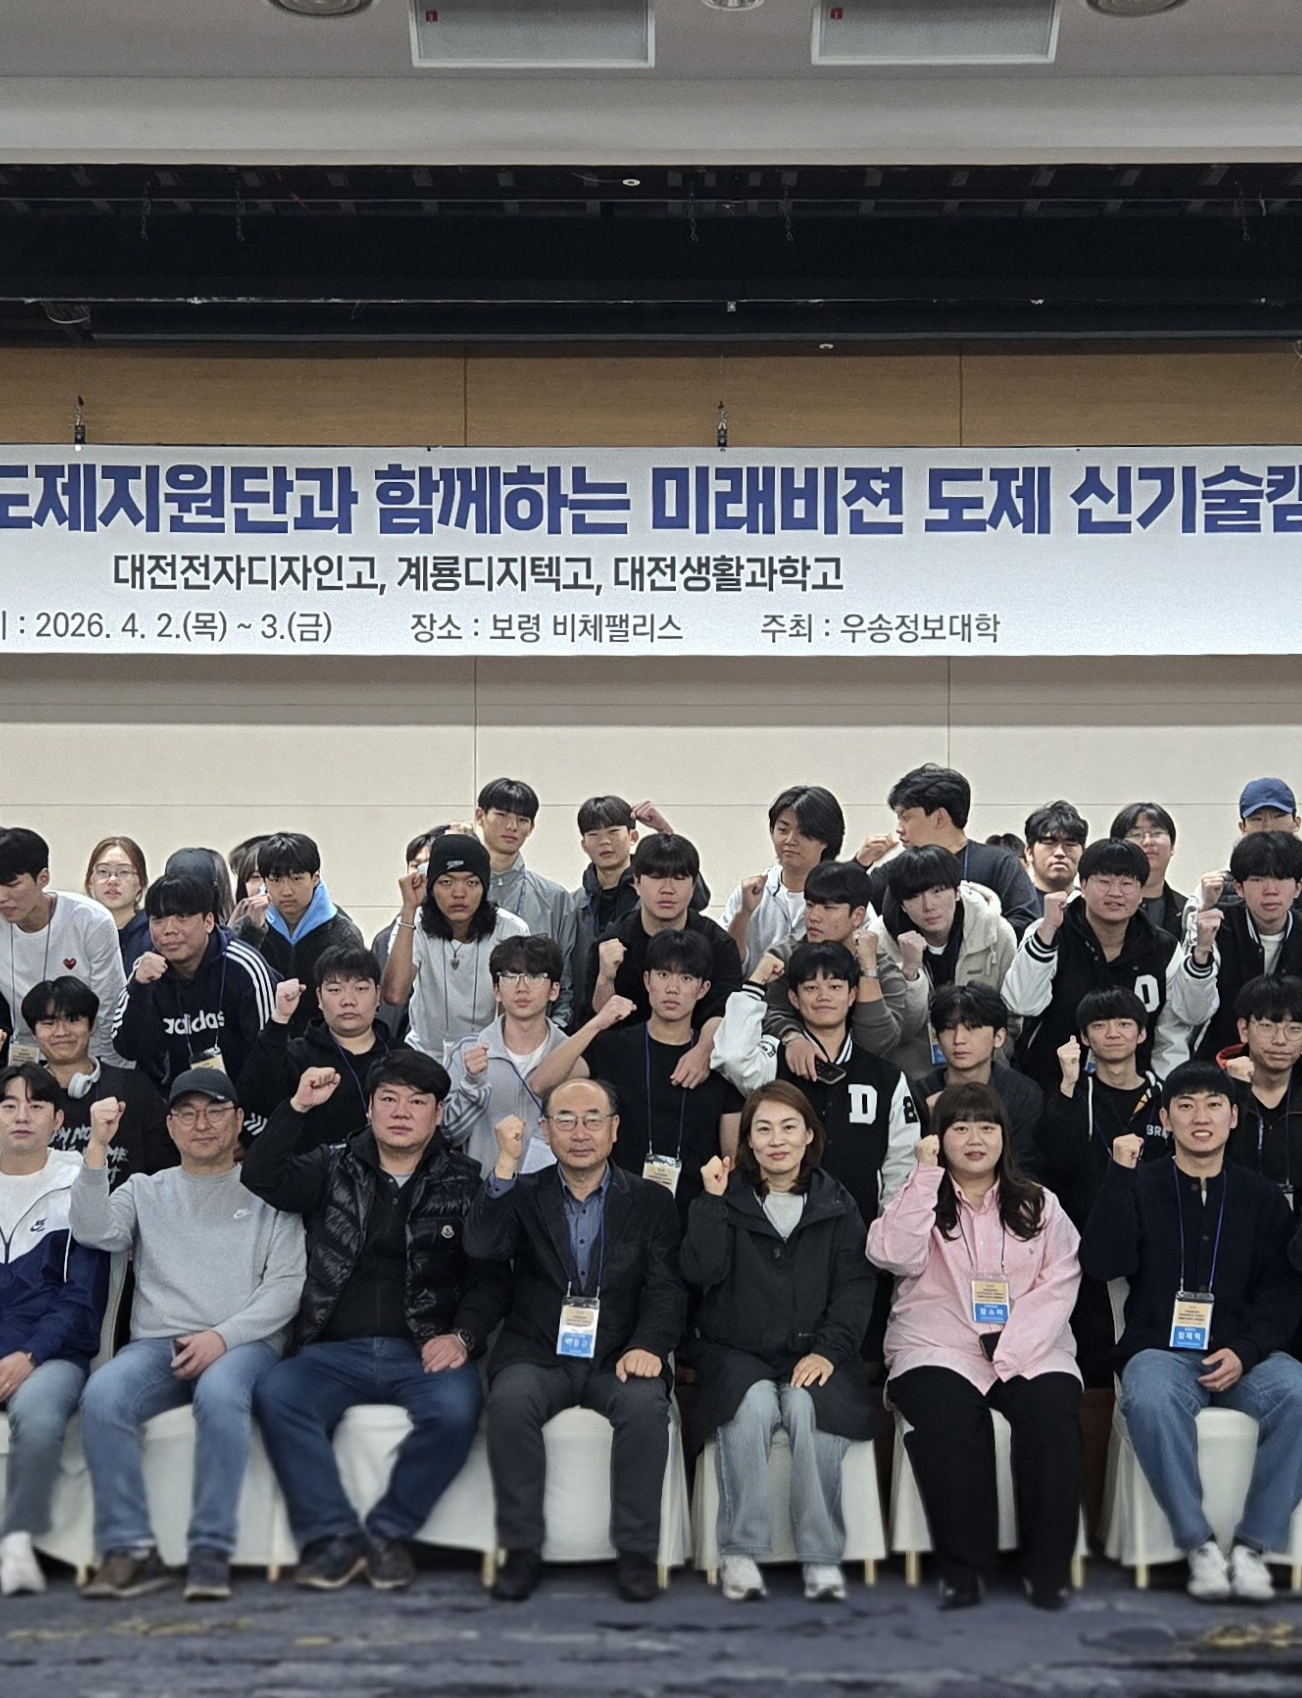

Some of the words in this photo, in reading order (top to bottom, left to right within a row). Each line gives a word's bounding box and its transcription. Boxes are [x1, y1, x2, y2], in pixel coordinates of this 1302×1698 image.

[374, 463, 631, 535] 함께하는
[651, 465, 904, 535] 미래비젼
[924, 466, 1051, 535] 도제
[114, 554, 387, 596] 대전전자디자인고,
[397, 555, 602, 596] 계룡디지텍고,
[614, 554, 844, 592] 대전생활과학고
[35, 612, 111, 639] 2026.
[121, 612, 145, 639] 4.
[157, 611, 227, 643] 2.(목)
[261, 611, 332, 643] 3.(금)
[410, 613, 463, 643] 장소
[489, 613, 540, 643] 보령
[553, 613, 683, 643] 비체팰리스
[761, 613, 812, 644] 주최
[840, 613, 1001, 644] 우송정보대학
[162, 1009, 225, 1035] adidas
[848, 1084, 878, 1125] D
